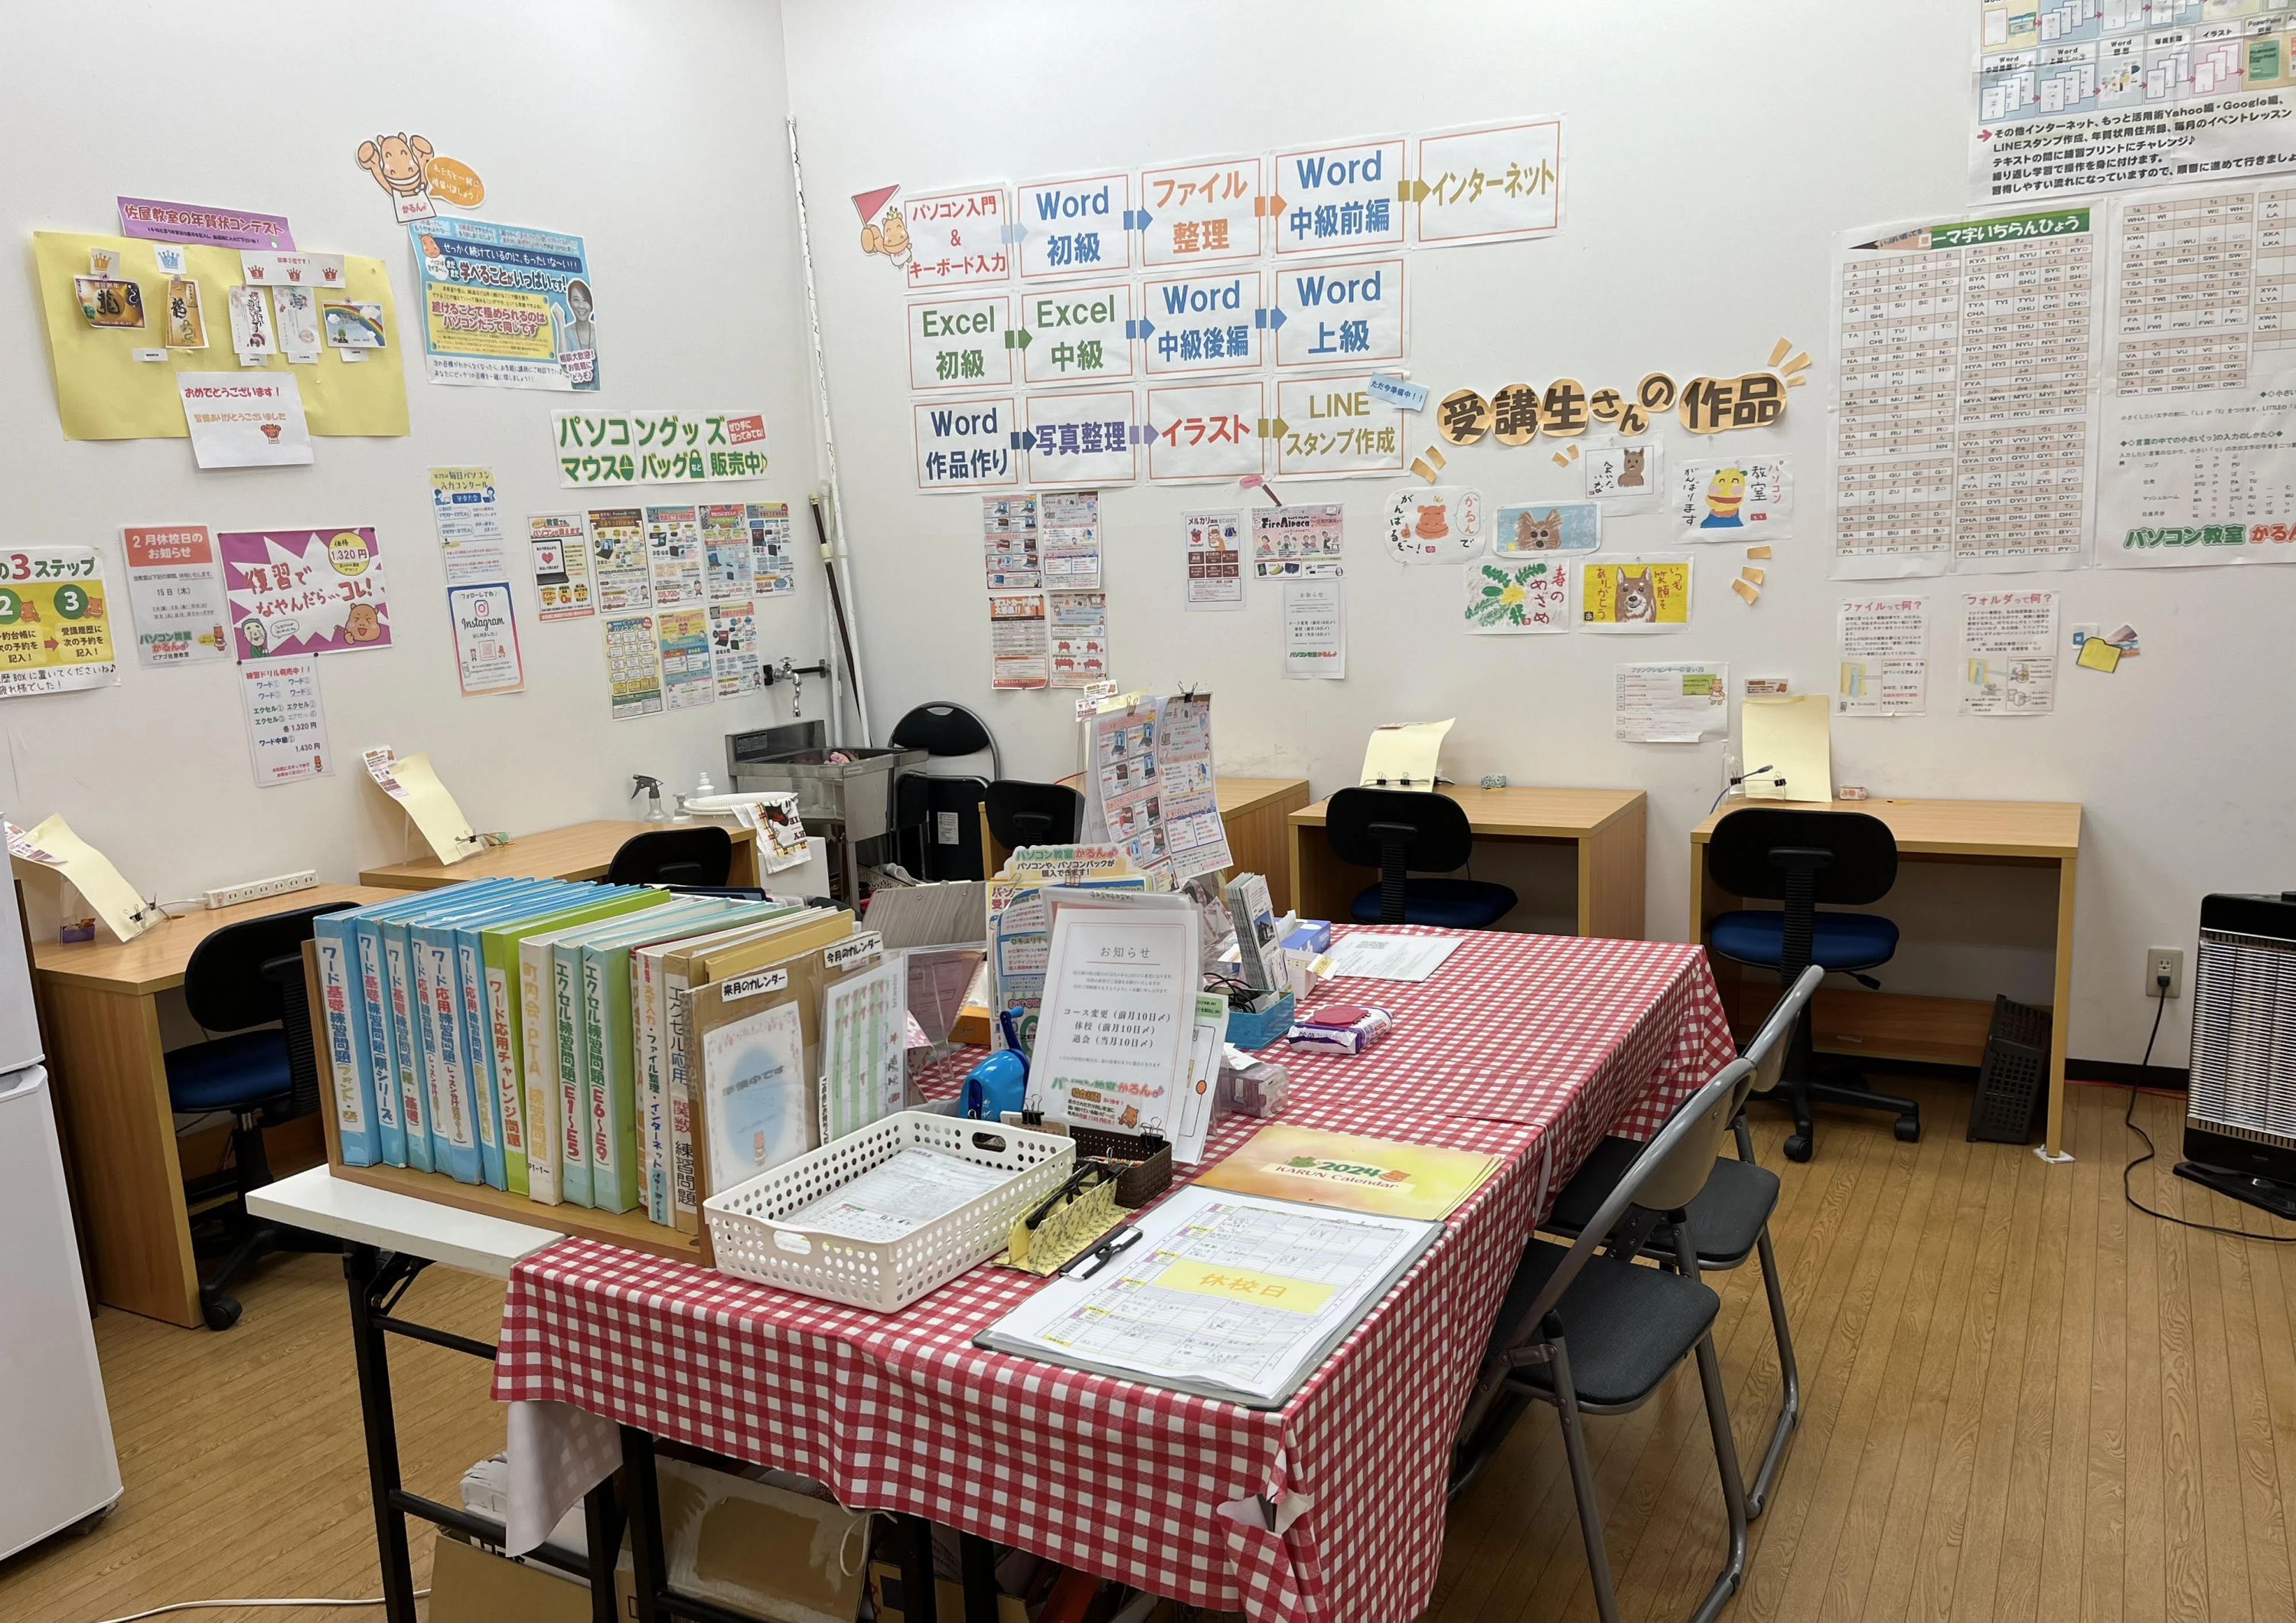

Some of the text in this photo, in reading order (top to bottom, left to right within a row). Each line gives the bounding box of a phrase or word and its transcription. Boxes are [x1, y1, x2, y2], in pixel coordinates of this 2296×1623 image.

[2203, 27, 2232, 38] イラスト
[2057, 47, 2078, 55] Word
[1296, 149, 1382, 189] Word
[1432, 158, 1554, 207] インターネット
[1036, 185, 1110, 220] Word
[1153, 171, 1249, 208] ファイル
[124, 204, 285, 237] 佐屋教室の年賀状コンテスト
[912, 195, 997, 221] パソコン入門
[1290, 198, 1390, 240] 中級前編
[951, 230, 962, 247] &
[1047, 232, 1101, 266] 初級
[1172, 218, 1229, 254] 整理
[909, 253, 1006, 278] キーボード入力
[1163, 279, 1241, 315] Word
[1296, 270, 1381, 307] Word
[922, 305, 995, 338] Excel
[1037, 295, 1115, 328] Excel
[1158, 325, 1249, 362] 中級後編
[1307, 319, 1370, 354] 上級
[935, 349, 985, 380] 初級
[1051, 340, 1104, 373] 中級
[184, 386, 280, 400] おめでとうございます！
[1309, 390, 1371, 419] LINE
[560, 416, 727, 447] パソコングッズ
[930, 407, 998, 437] Word
[1162, 414, 1251, 447] イラスト
[1035, 420, 1127, 456] 写真整理
[1286, 426, 1396, 456] スタンプ作成
[562, 456, 621, 481] マウス
[641, 451, 688, 478] バッグ
[926, 448, 1008, 481] 作品作り
[441, 482, 488, 490] 入力コンクール
[1682, 468, 1698, 526] がんばります
[1750, 465, 1768, 501] 教室
[1769, 460, 1784, 504] パソコン
[1261, 518, 1309, 528] FireAlpaca
[2125, 524, 2245, 549] パソコン教室
[148, 547, 191, 559] お知らせ
[244, 562, 312, 594] 復習で
[1551, 564, 1567, 603] 春の
[1654, 570, 1670, 610] 笑顔を
[1670, 567, 1682, 591] いつも
[0, 596, 13, 616] 2
[64, 591, 79, 611] 3
[1531, 578, 1550, 625] めざめ
[1596, 567, 1612, 620] ありがとう
[1843, 601, 1922, 612] ファイルって何？
[1967, 594, 2052, 606] フォルダって何？
[0, 630, 36, 639] 約台帳に
[61, 625, 103, 635] 受講履歴に
[461, 616, 505, 632] Instagram
[64, 635, 103, 646] 次の予約を
[77, 648, 98, 657] 記入！
[8, 653, 31, 663] 記入！
[14, 673, 27, 681] BOX
[1016, 848, 1075, 861] パソコン教室
[826, 938, 881, 963] 今月のカレンダー
[1101, 946, 1150, 958] お知らせ
[723, 974, 786, 996] 来月のカレンダー
[490, 980, 522, 1148] ワード応用チャレンジ問題
[673, 1099, 692, 1134] 関数
[675, 1141, 697, 1207] 練習問題
[1275, 1166, 1399, 1189] KARUN Calendar
[1317, 1161, 1382, 1177] 2024
[1200, 1273, 1287, 1298] 休校日
